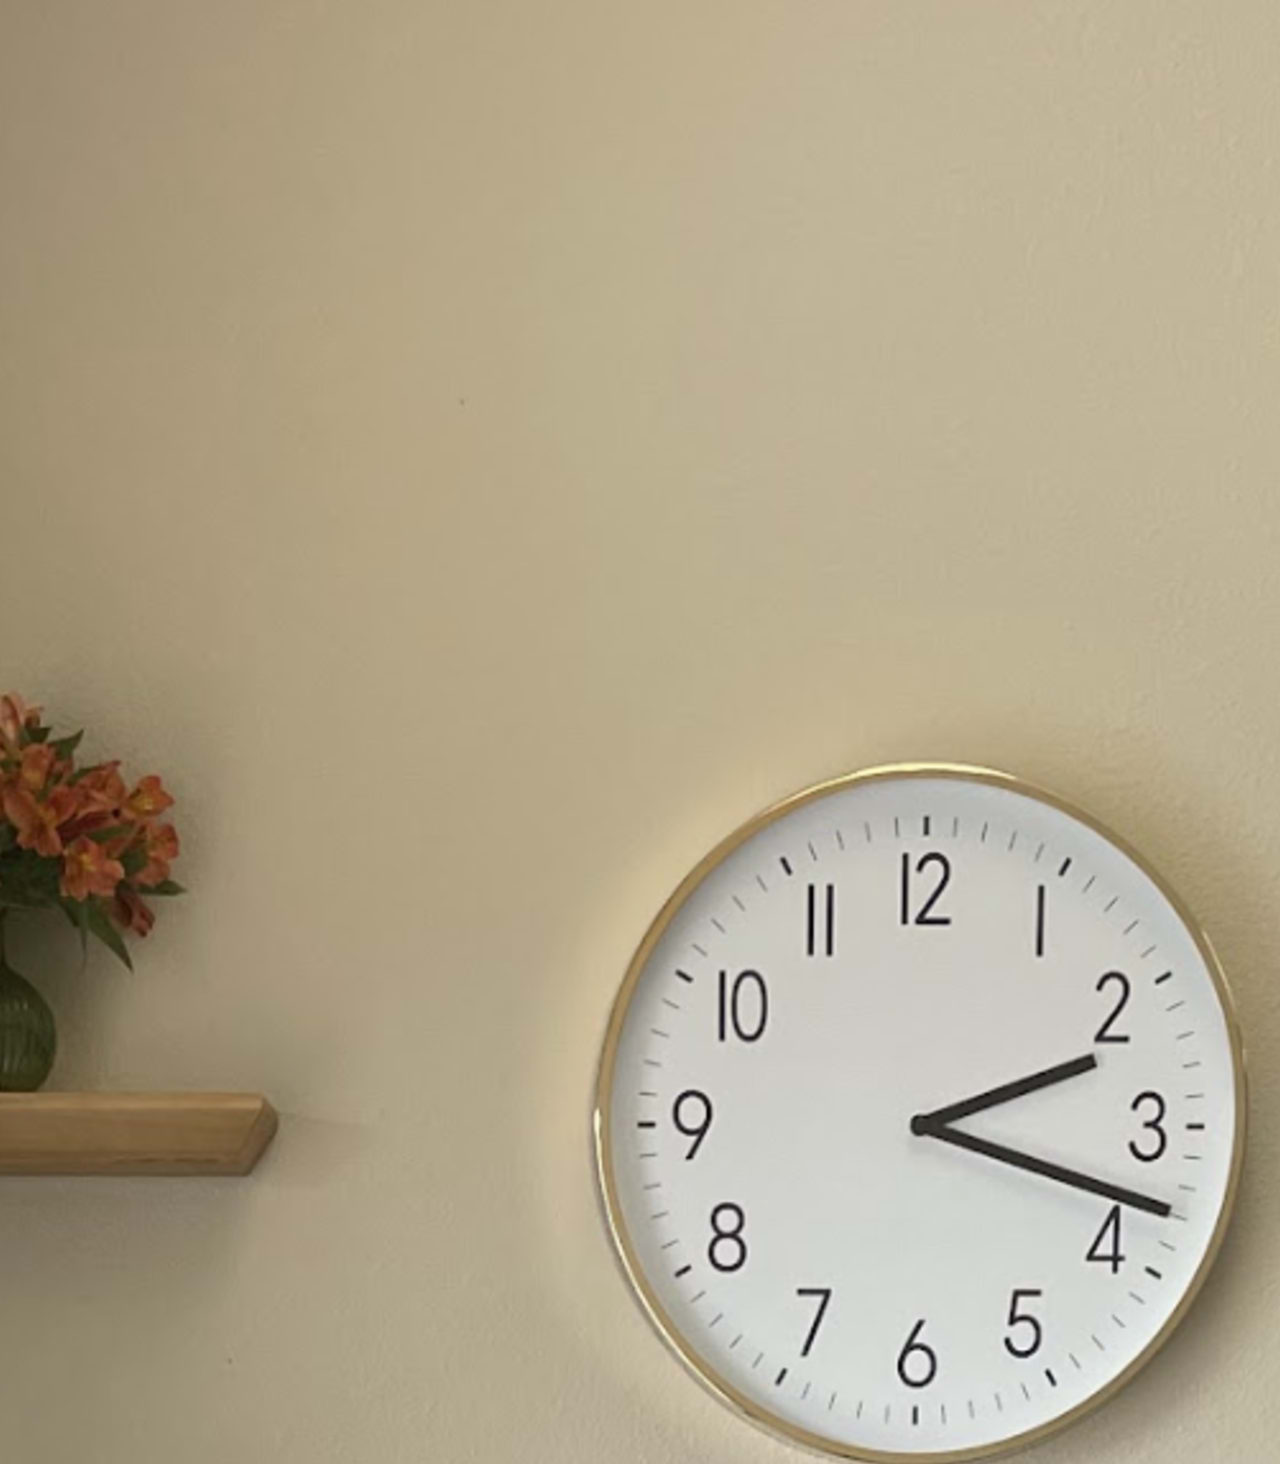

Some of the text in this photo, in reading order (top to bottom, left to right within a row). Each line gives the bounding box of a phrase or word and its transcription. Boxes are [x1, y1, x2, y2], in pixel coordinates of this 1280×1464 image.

[806, 883, 835, 957] 11
[900, 851, 952, 926] 12
[1035, 884, 1045, 958] 1
[718, 969, 768, 1043] 10
[1093, 970, 1131, 1044] 2
[672, 1089, 713, 1161] 9
[1128, 1090, 1167, 1163] 3
[707, 1202, 747, 1273] 8
[1085, 1205, 1126, 1275] 4
[796, 1288, 832, 1357] 7
[897, 1319, 937, 1389] 6
[1003, 1288, 1042, 1359] 5
